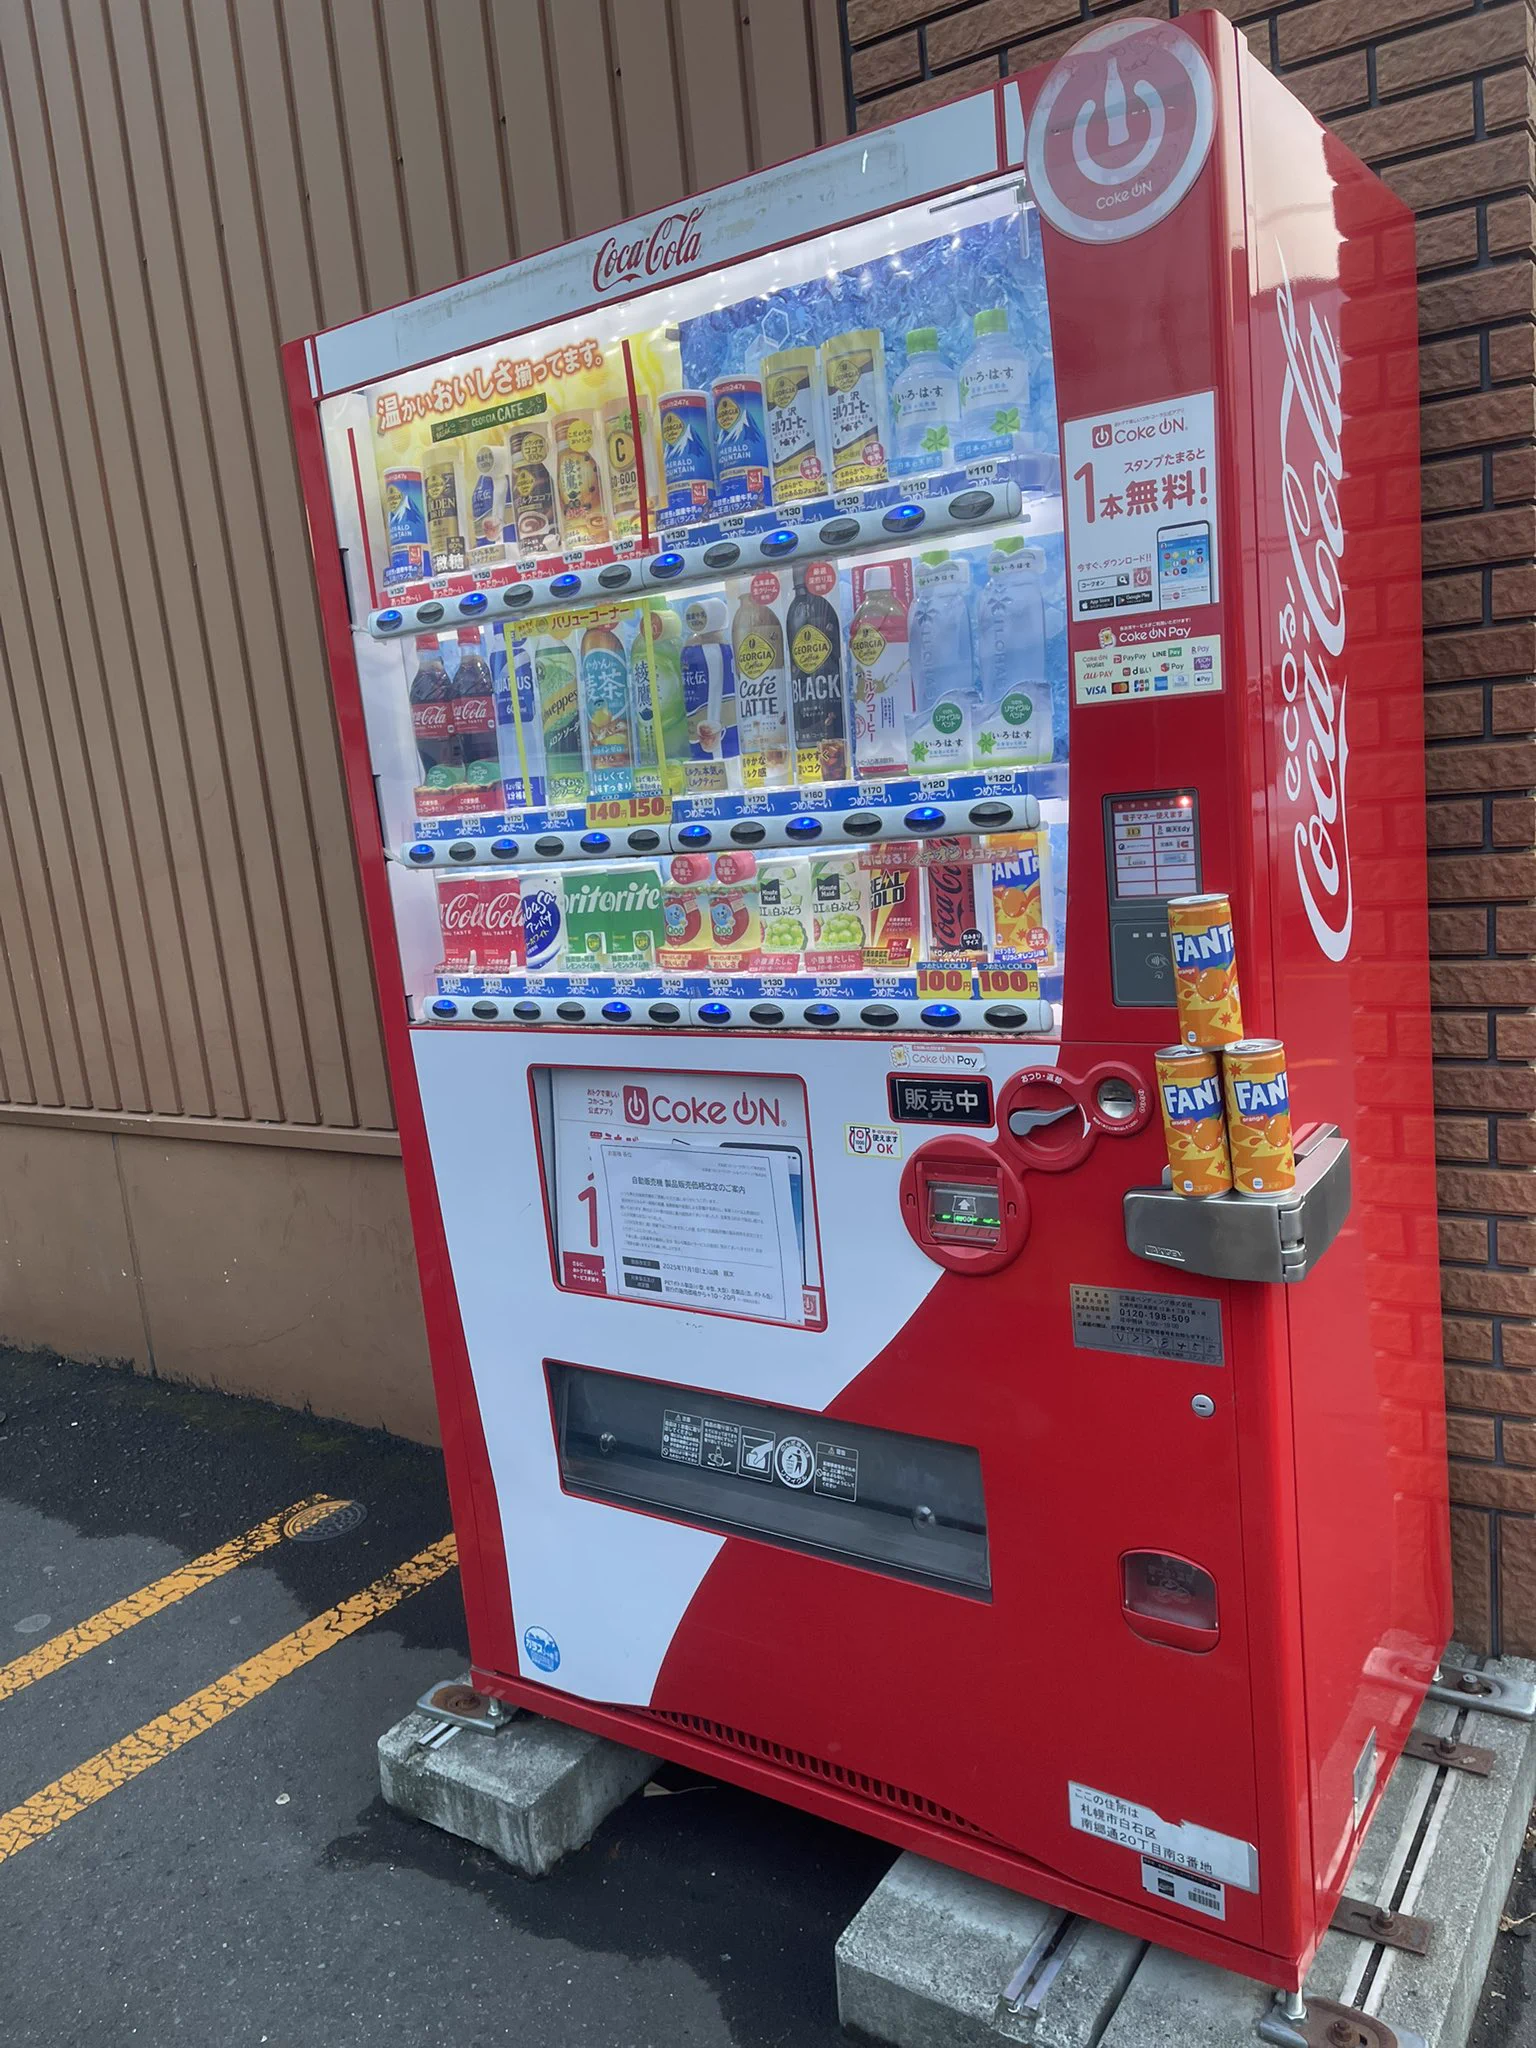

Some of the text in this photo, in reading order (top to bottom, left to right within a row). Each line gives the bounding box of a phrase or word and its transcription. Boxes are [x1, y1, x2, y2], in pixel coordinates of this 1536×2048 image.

[1095, 180, 1153, 210] Coke ON
[592, 206, 706, 293] Coca-Cola
[378, 339, 603, 430] 温かいおいしさ揃ってます。
[471, 402, 524, 427] GEORGIA CAFE
[832, 400, 870, 421] ミルクコーヒー
[772, 416, 807, 436] ミルクコーヒー
[1114, 416, 1186, 445] Coke ON
[1124, 447, 1207, 474] スタンプたまると
[968, 465, 994, 476] ¥110
[901, 482, 927, 492] ¥110
[1073, 461, 1208, 525] 1本無料!
[836, 496, 859, 506] ¥130
[778, 507, 800, 517] ¥130
[722, 517, 743, 527] ¥130
[666, 530, 686, 539] ¥130
[435, 553, 464, 571] 微糖
[1140, 592, 1150, 600] Play
[1274, 236, 1352, 964] Coca-Cola
[551, 606, 630, 630] バリューコーナー
[1118, 626, 1192, 643] Coke ON Pay
[853, 639, 883, 650] GEORGIA
[1197, 645, 1210, 654] Pay
[1122, 653, 1147, 662] PayPay
[1152, 650, 1167, 658] LINE
[1171, 663, 1185, 671] Pay
[1083, 671, 1098, 681] au
[739, 675, 777, 699] Café
[792, 673, 841, 704] BLACK
[1085, 685, 1107, 696] VISA
[740, 696, 779, 718] LATTE
[863, 669, 877, 743] ミルクコーヒー
[1004, 705, 1031, 713] リサイクル
[987, 774, 1012, 782] ¥120
[862, 785, 883, 795] ¥170
[922, 781, 945, 789] ¥120
[973, 784, 1022, 796] つめた〜い
[848, 791, 893, 806] つめた〜い
[909, 789, 955, 800] つめた〜い
[589, 802, 627, 821] 140円
[628, 796, 672, 819] 150円
[1122, 810, 1184, 822] 電子マネー使えます
[761, 888, 778, 896] Minute
[818, 884, 838, 893] Minute
[819, 890, 838, 898] Maid
[525, 910, 552, 934] アンバサ
[667, 926, 684, 934] Qoo
[715, 925, 731, 934] Qoo
[1172, 924, 1234, 964] FANT
[810, 956, 856, 964] 小腹満たしに
[944, 962, 968, 970] COLD
[712, 978, 730, 986] ¥140
[763, 978, 783, 986] ¥130
[819, 977, 838, 986] ¥130
[875, 977, 897, 985] ¥140
[917, 970, 971, 992] 100円
[980, 971, 1039, 993] 100円
[707, 987, 745, 997] つめた〜い
[759, 987, 799, 998] つめた〜い
[813, 987, 854, 998] つめた〜い
[869, 987, 913, 998] つめた〜い
[912, 1053, 978, 1068] Coke ON Pay
[1020, 1072, 1064, 1085] おつり・返却
[586, 1088, 620, 1099] おトクで楽しい
[587, 1097, 614, 1107] コカ・コーラ
[904, 1088, 979, 1113] 販売中
[588, 1107, 614, 1116] 公式アプリ
[652, 1091, 781, 1128] Coke ON
[1242, 1115, 1265, 1123] orange
[872, 1134, 898, 1143] 使えます
[877, 1143, 894, 1155] OK
[631, 1175, 746, 1195] 自動販売機 製品販売価格改定のご案内
[1119, 1308, 1191, 1324] 0120-198-509
[780, 1469, 808, 1485] リサイクル
[1074, 1788, 1139, 1819] ここの住所は
[1080, 1802, 1158, 1840] 札幌市白石区
[1080, 1816, 1213, 1875] 南郷通20丁目南3番地
